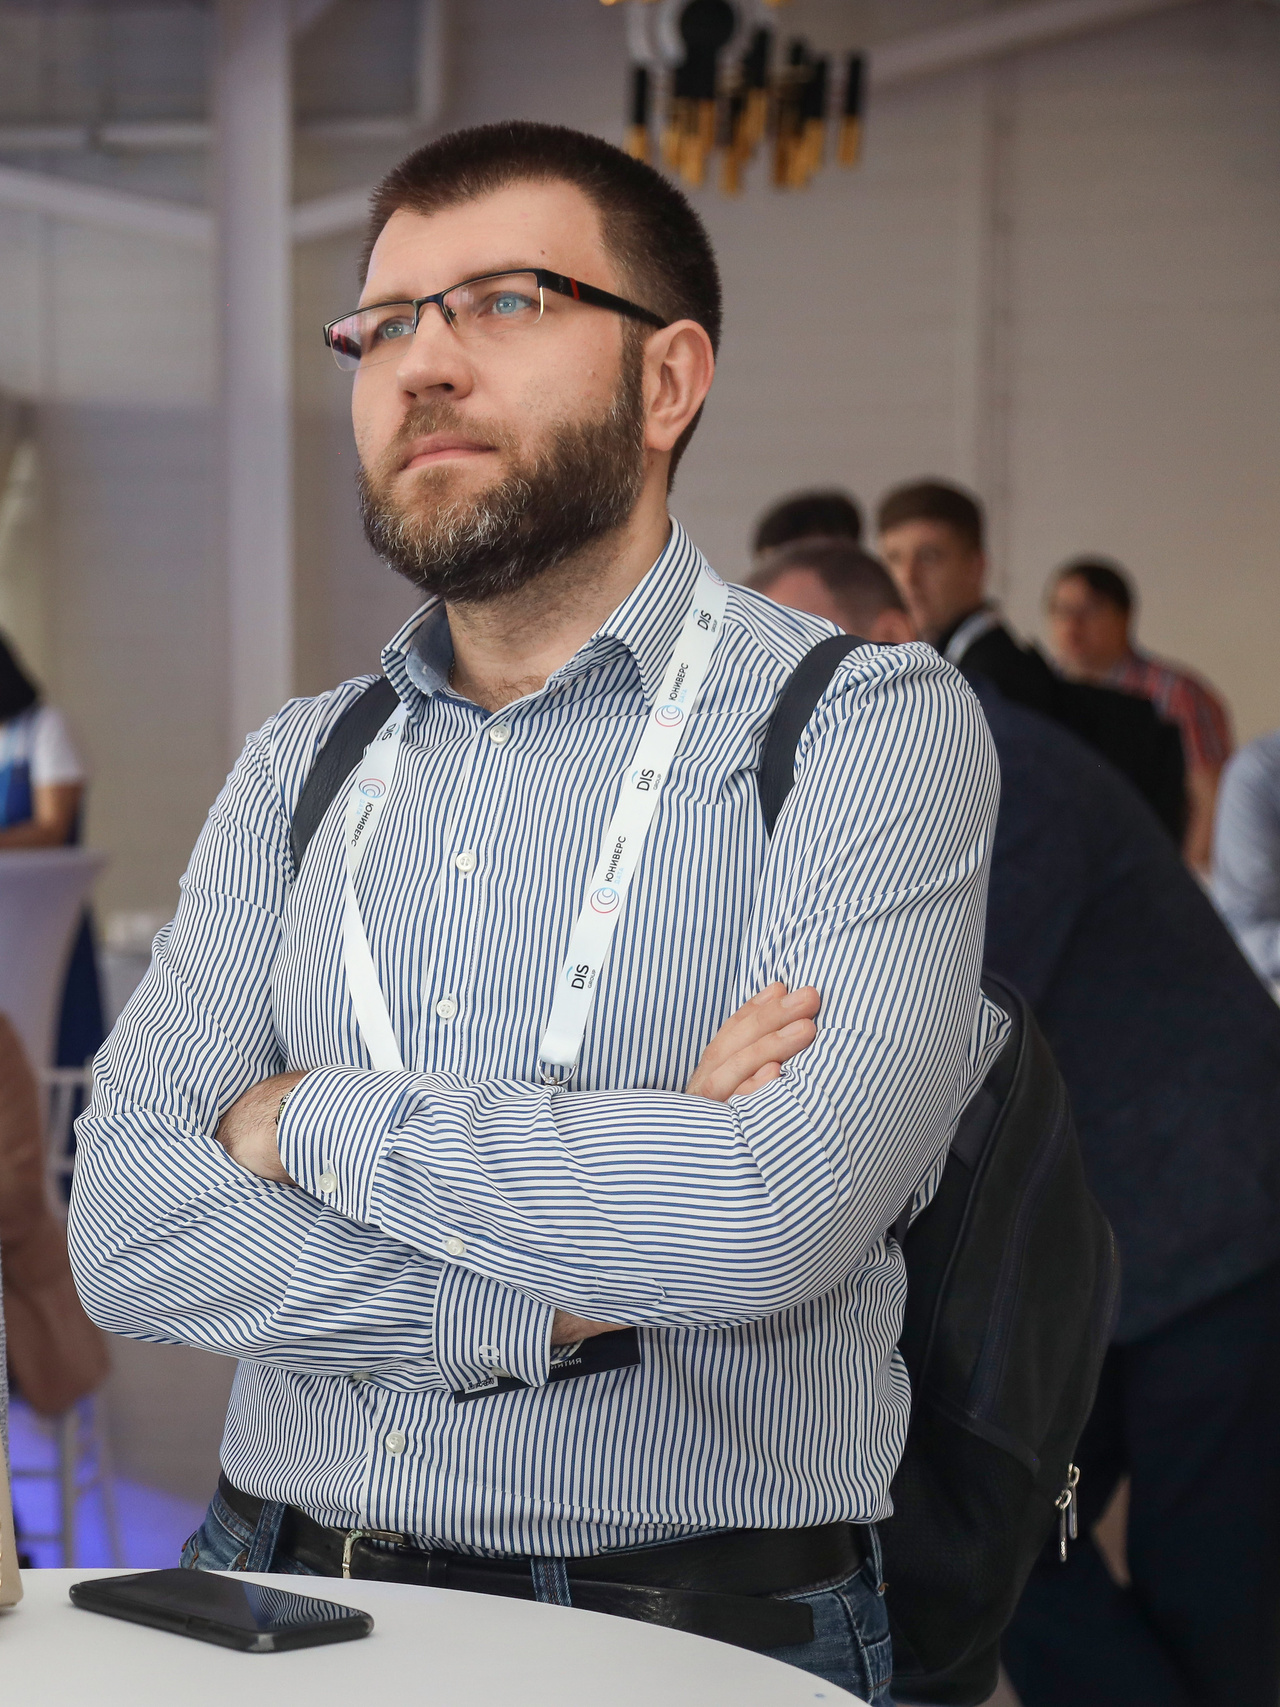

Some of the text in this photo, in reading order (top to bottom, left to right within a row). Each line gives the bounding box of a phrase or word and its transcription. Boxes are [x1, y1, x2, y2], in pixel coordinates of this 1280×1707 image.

[697, 609, 712, 631] DIS
[669, 662, 689, 701] ЮНИВЕРС
[382, 722, 397, 741] DIS
[636, 768, 655, 791] DIS
[351, 802, 374, 847] ЮНИВЕРС
[604, 835, 627, 882] ЮНИВЕРС
[571, 964, 590, 990] DIS
[587, 969, 596, 989] GROUP
